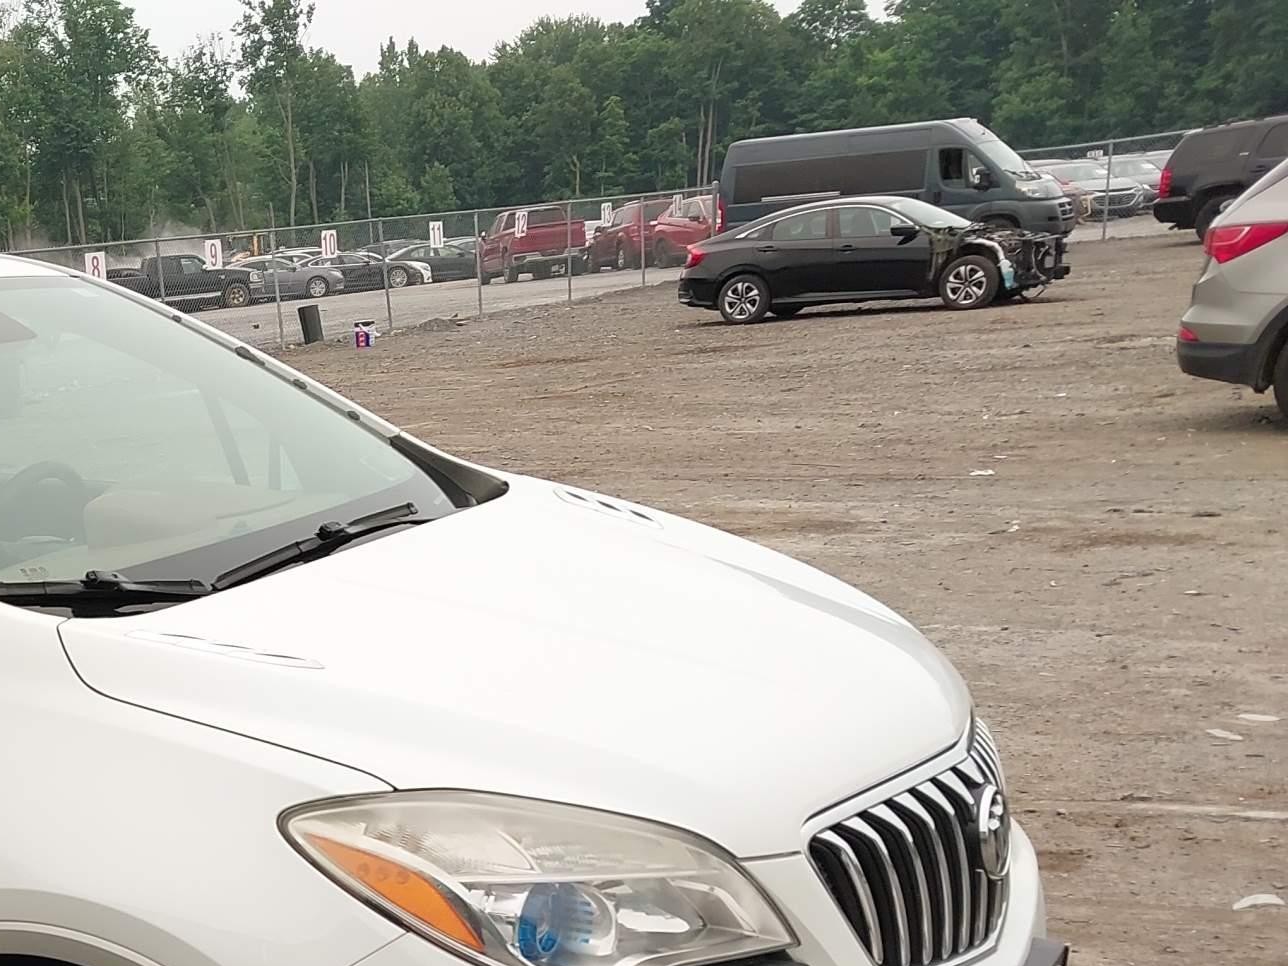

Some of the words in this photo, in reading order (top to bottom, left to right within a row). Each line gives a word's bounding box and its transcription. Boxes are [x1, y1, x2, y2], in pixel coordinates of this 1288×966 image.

[516, 213, 527, 235] 12
[602, 204, 612, 225] 13
[322, 233, 336, 257] 10
[432, 223, 441, 246] 11
[92, 255, 100, 278] 8
[210, 243, 218, 267] 9
